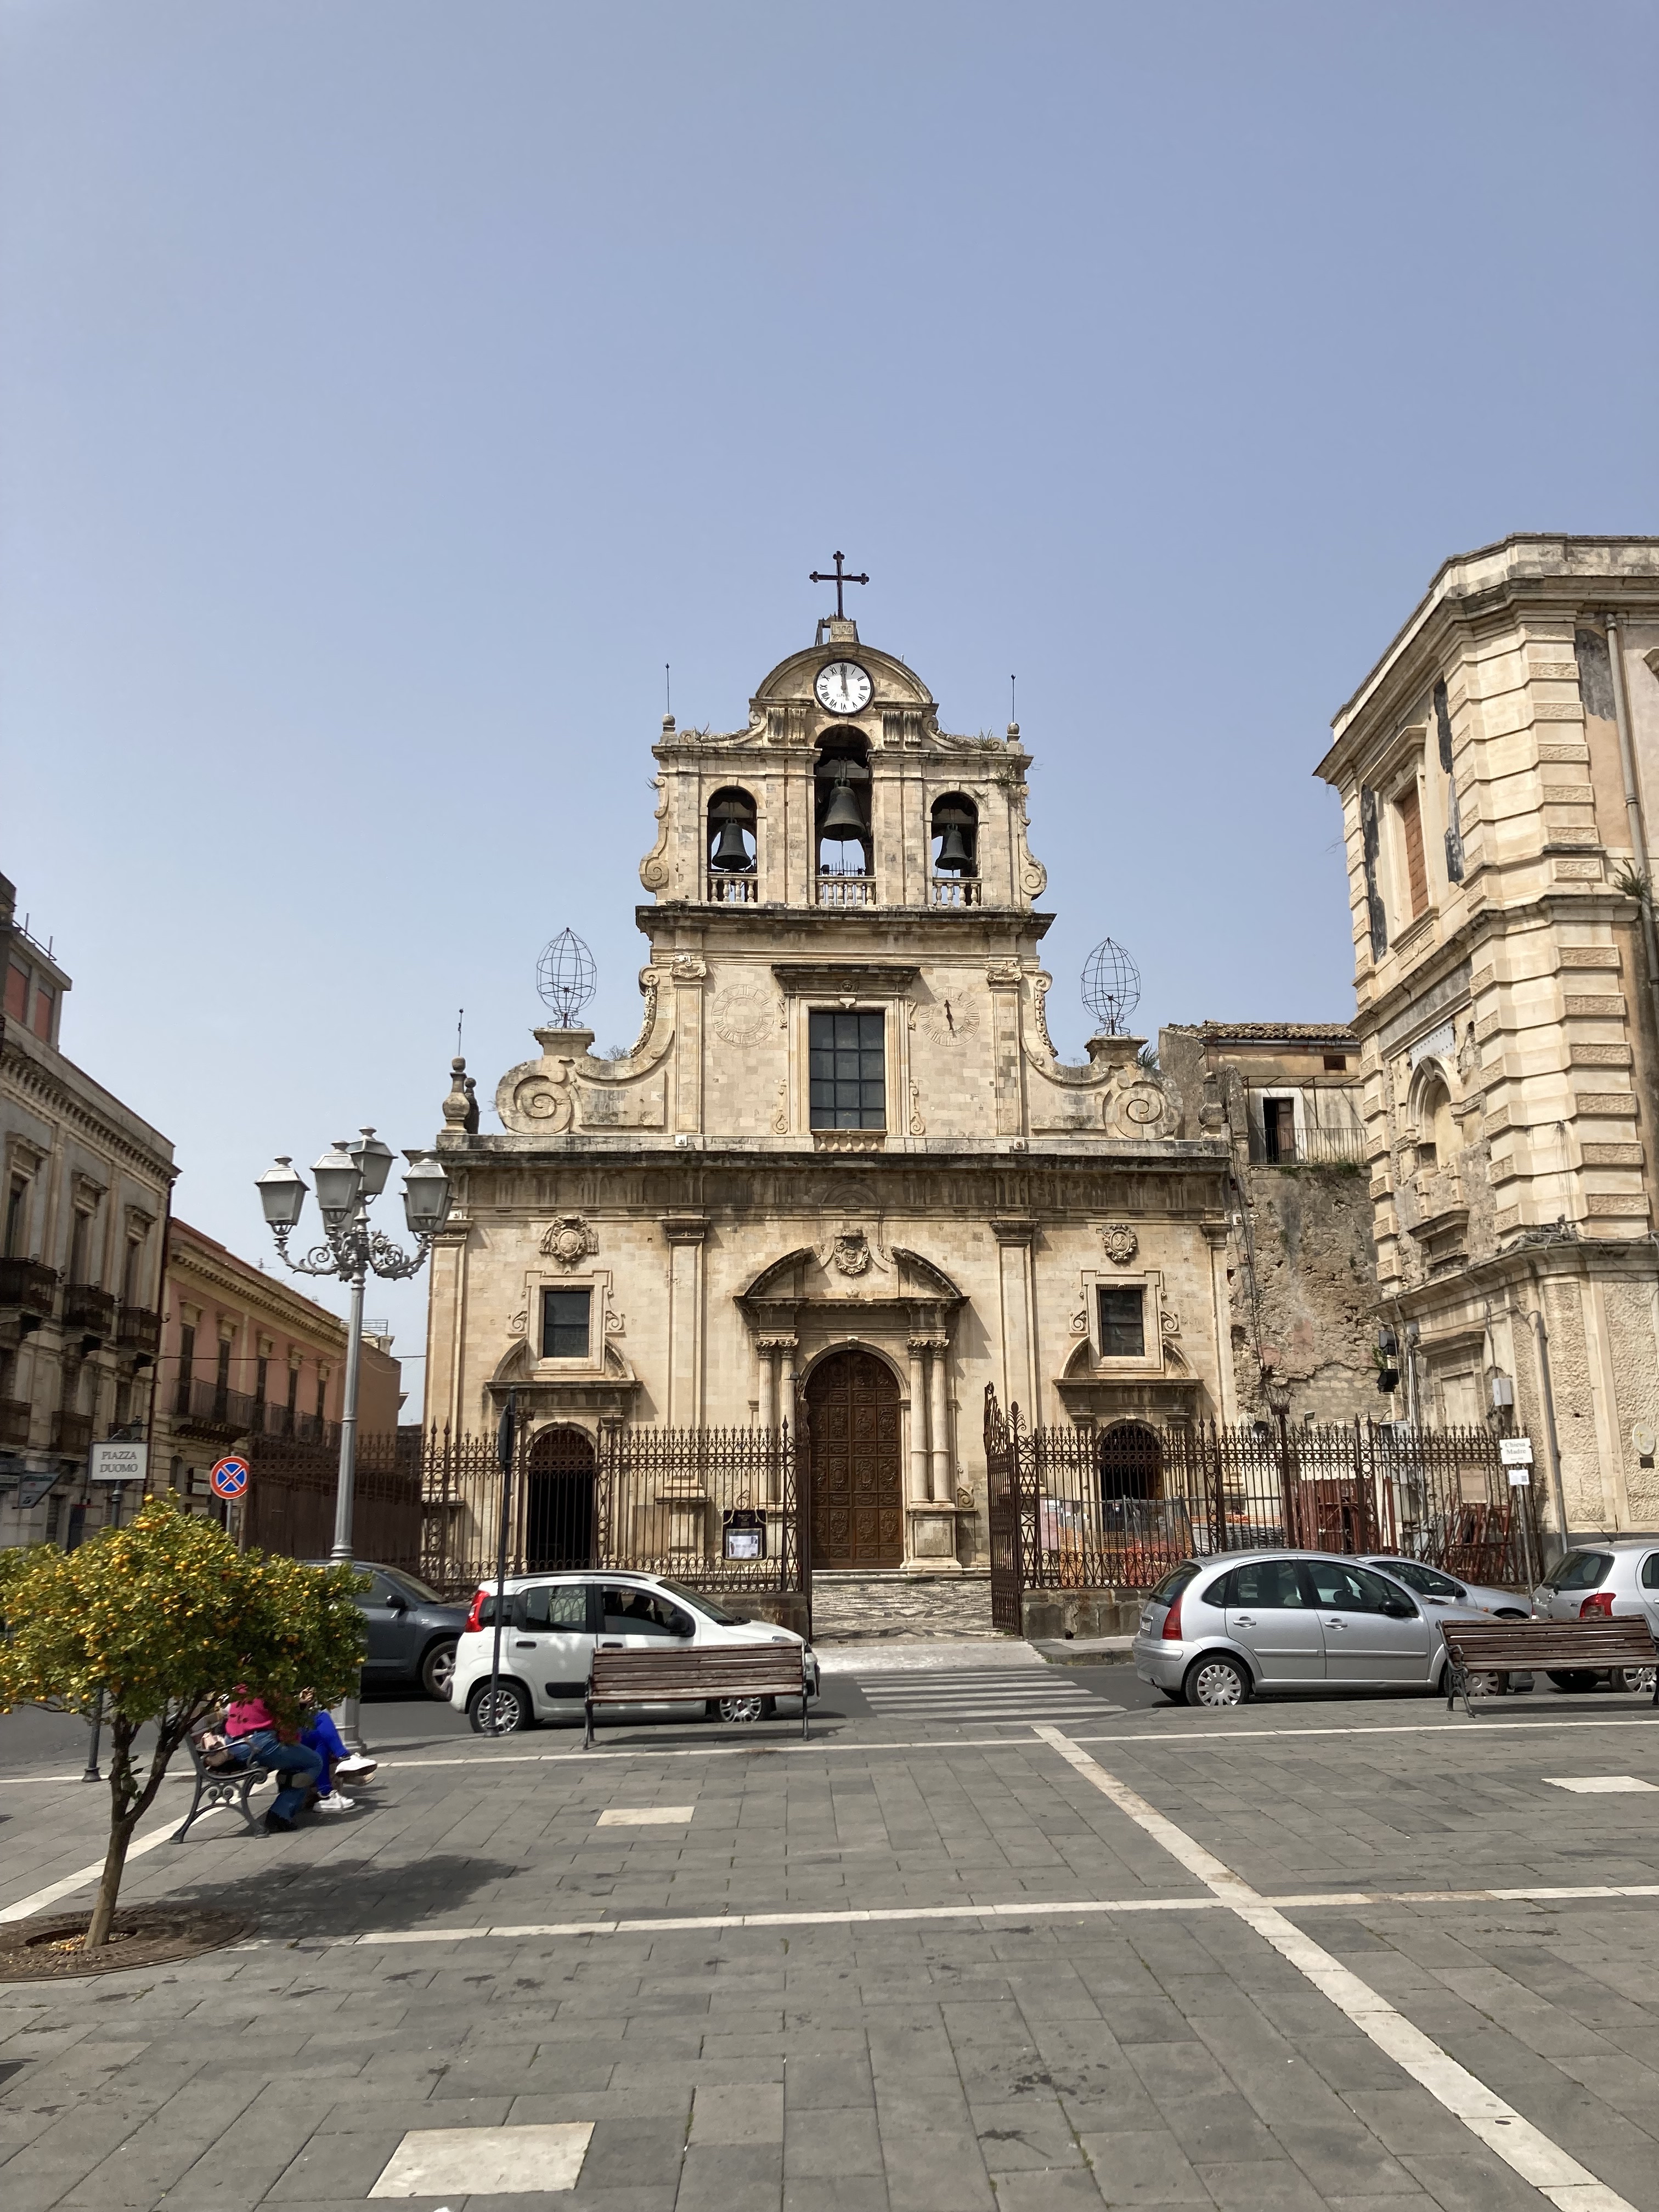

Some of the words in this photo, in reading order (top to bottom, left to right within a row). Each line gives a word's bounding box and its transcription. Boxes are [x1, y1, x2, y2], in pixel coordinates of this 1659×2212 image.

[830, 667, 838, 675] XI
[821, 692, 831, 702] VIII
[829, 699, 837, 708] VII
[101, 1451, 137, 1460] PIAZZA
[99, 1463, 138, 1472] DUOMO
